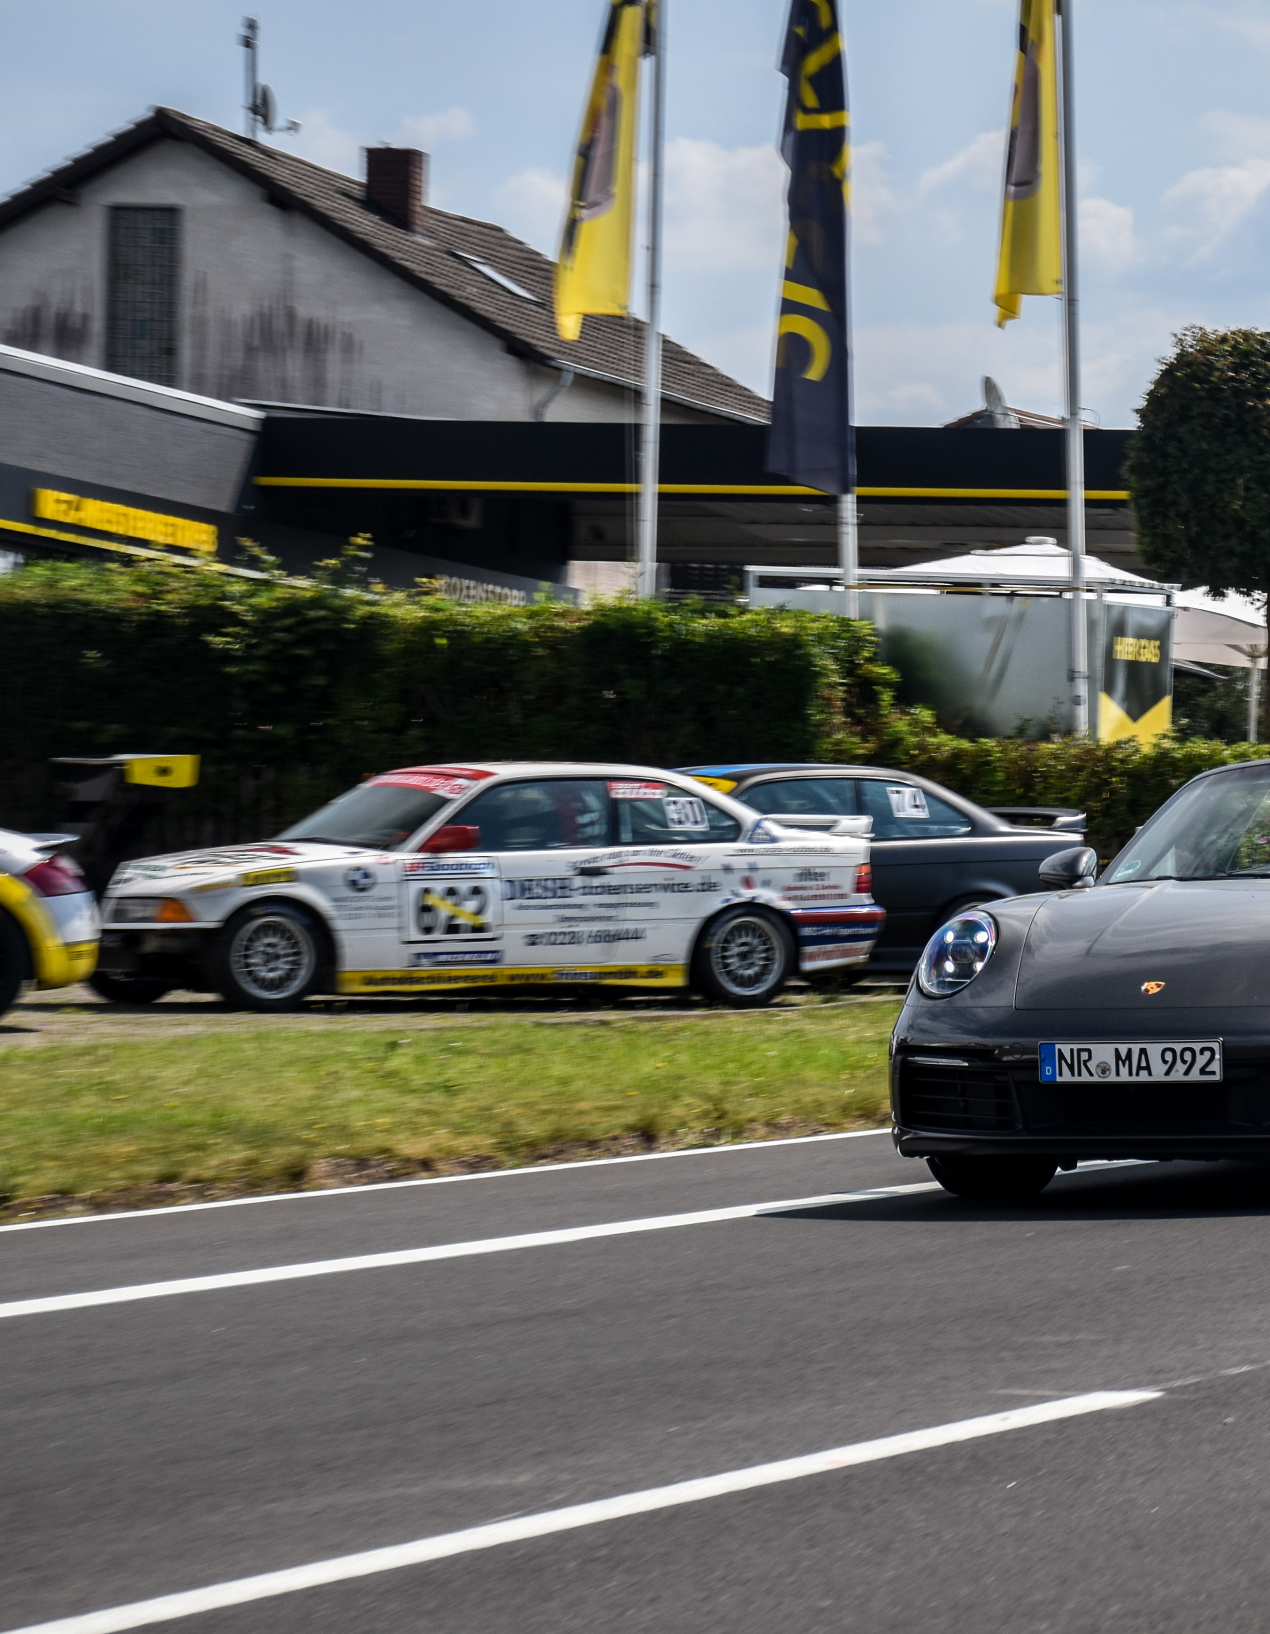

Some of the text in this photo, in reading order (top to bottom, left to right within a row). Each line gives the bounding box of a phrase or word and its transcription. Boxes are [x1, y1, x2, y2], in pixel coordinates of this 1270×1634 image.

[1057, 1047, 1094, 1077] NR
[1114, 1047, 1152, 1077] MA
[1160, 1046, 1217, 1076] 992
